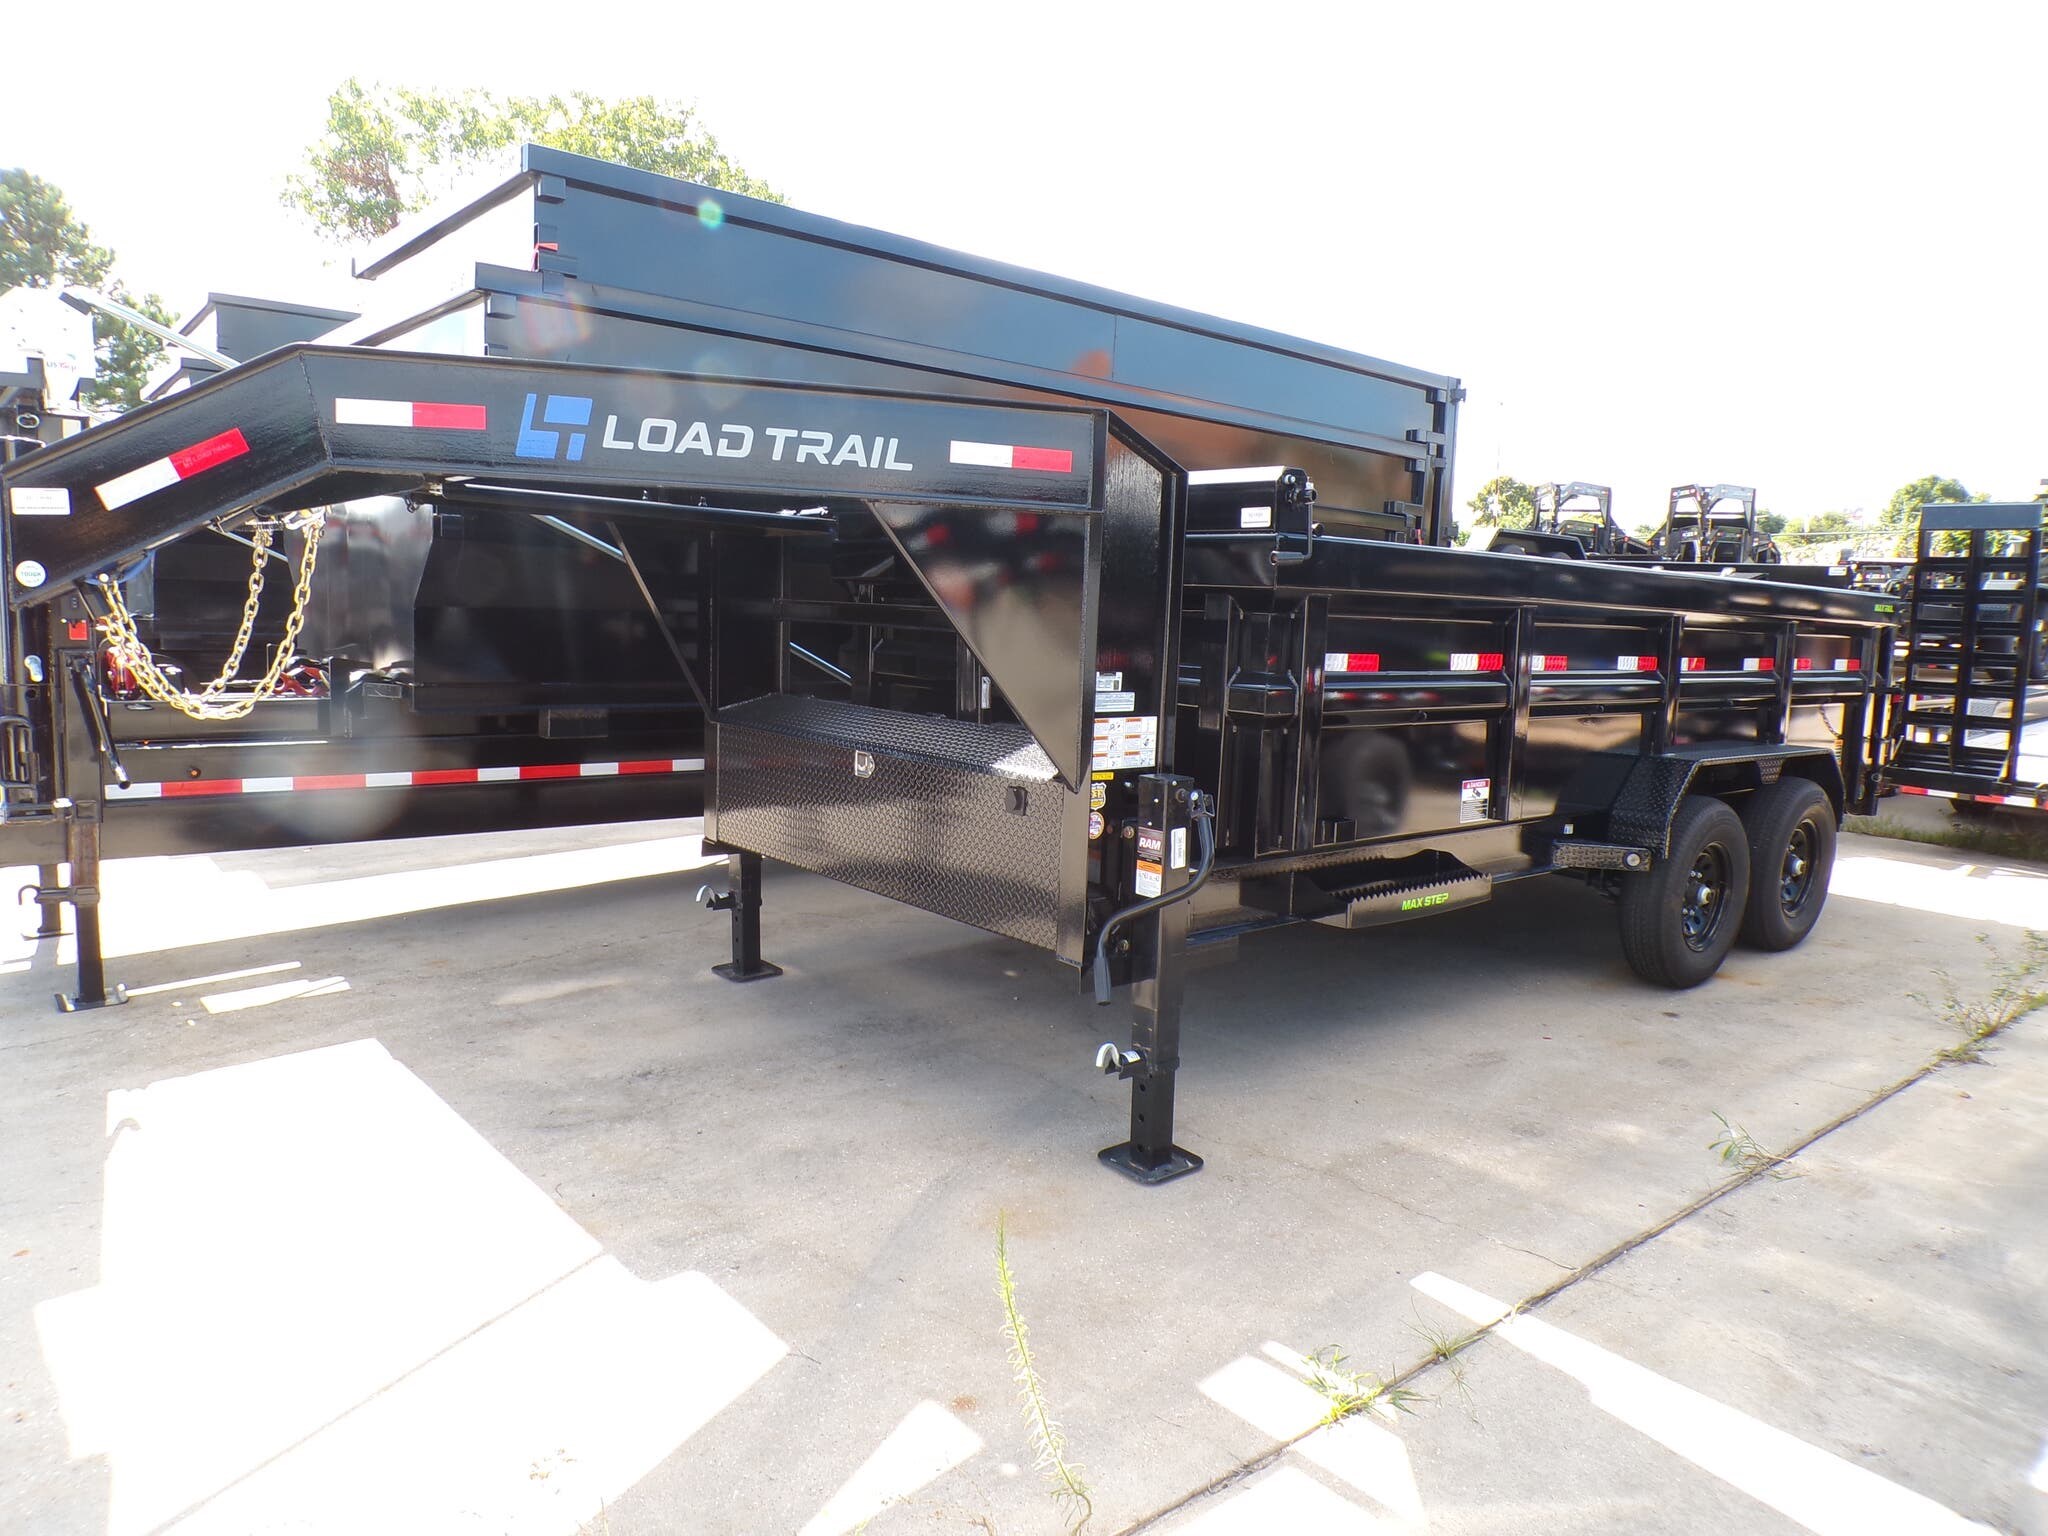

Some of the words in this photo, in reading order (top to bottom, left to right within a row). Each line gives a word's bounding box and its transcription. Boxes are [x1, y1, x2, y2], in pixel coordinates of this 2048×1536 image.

[603, 415, 753, 458] LOAD
[764, 427, 913, 471] TRAIL
[1139, 837, 1162, 851] RAM
[1401, 898, 1424, 911] MAX
[1423, 892, 1449, 906] STEP
